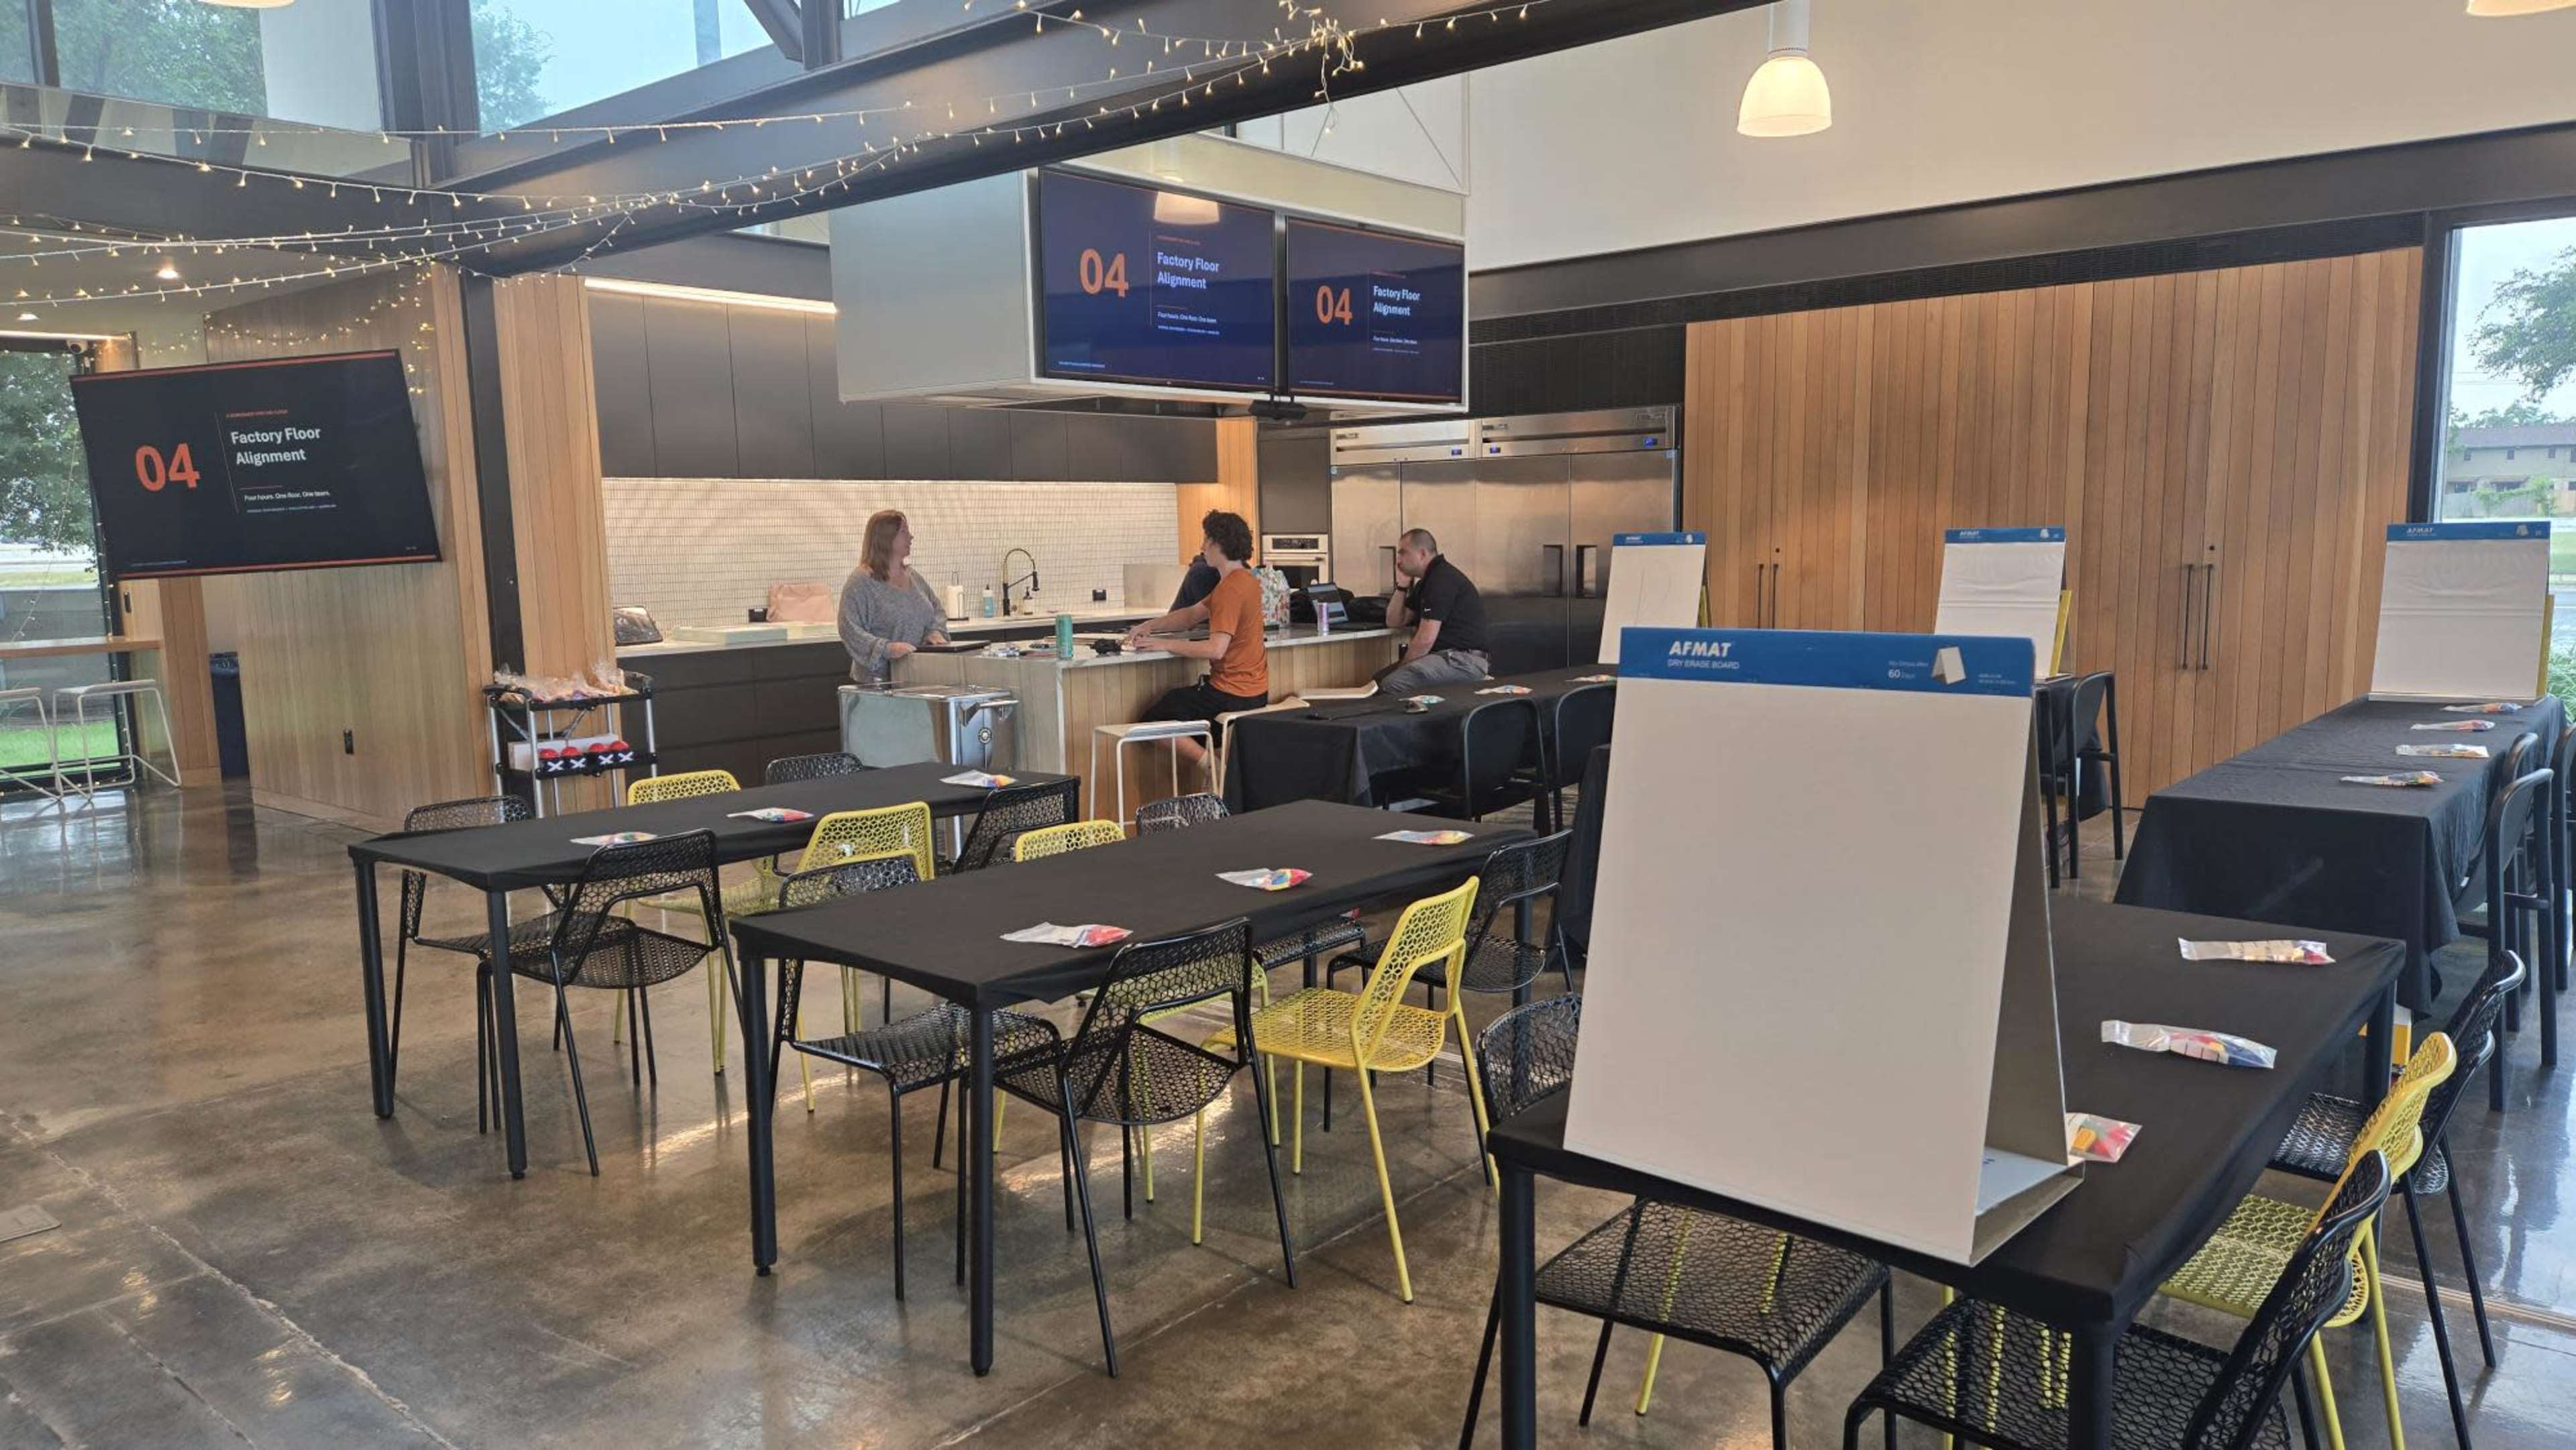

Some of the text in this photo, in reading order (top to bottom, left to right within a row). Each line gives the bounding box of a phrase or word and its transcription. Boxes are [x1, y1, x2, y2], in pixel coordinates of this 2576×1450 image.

[1157, 252, 1220, 272] Factory Floor
[1080, 248, 1128, 298] 04
[1157, 272, 1206, 289] Alignment
[1373, 286, 1421, 302] Factory Floor
[1317, 286, 1352, 325] 04
[1373, 303, 1411, 317] Alignment
[230, 427, 321, 444] Factory Floor
[236, 449, 306, 465] Alignment
[135, 443, 200, 492] 04
[1669, 640, 1731, 657] AFMAT
[1668, 659, 1739, 669] DRY ERASE BOARD
[1888, 669, 1900, 679] 60
